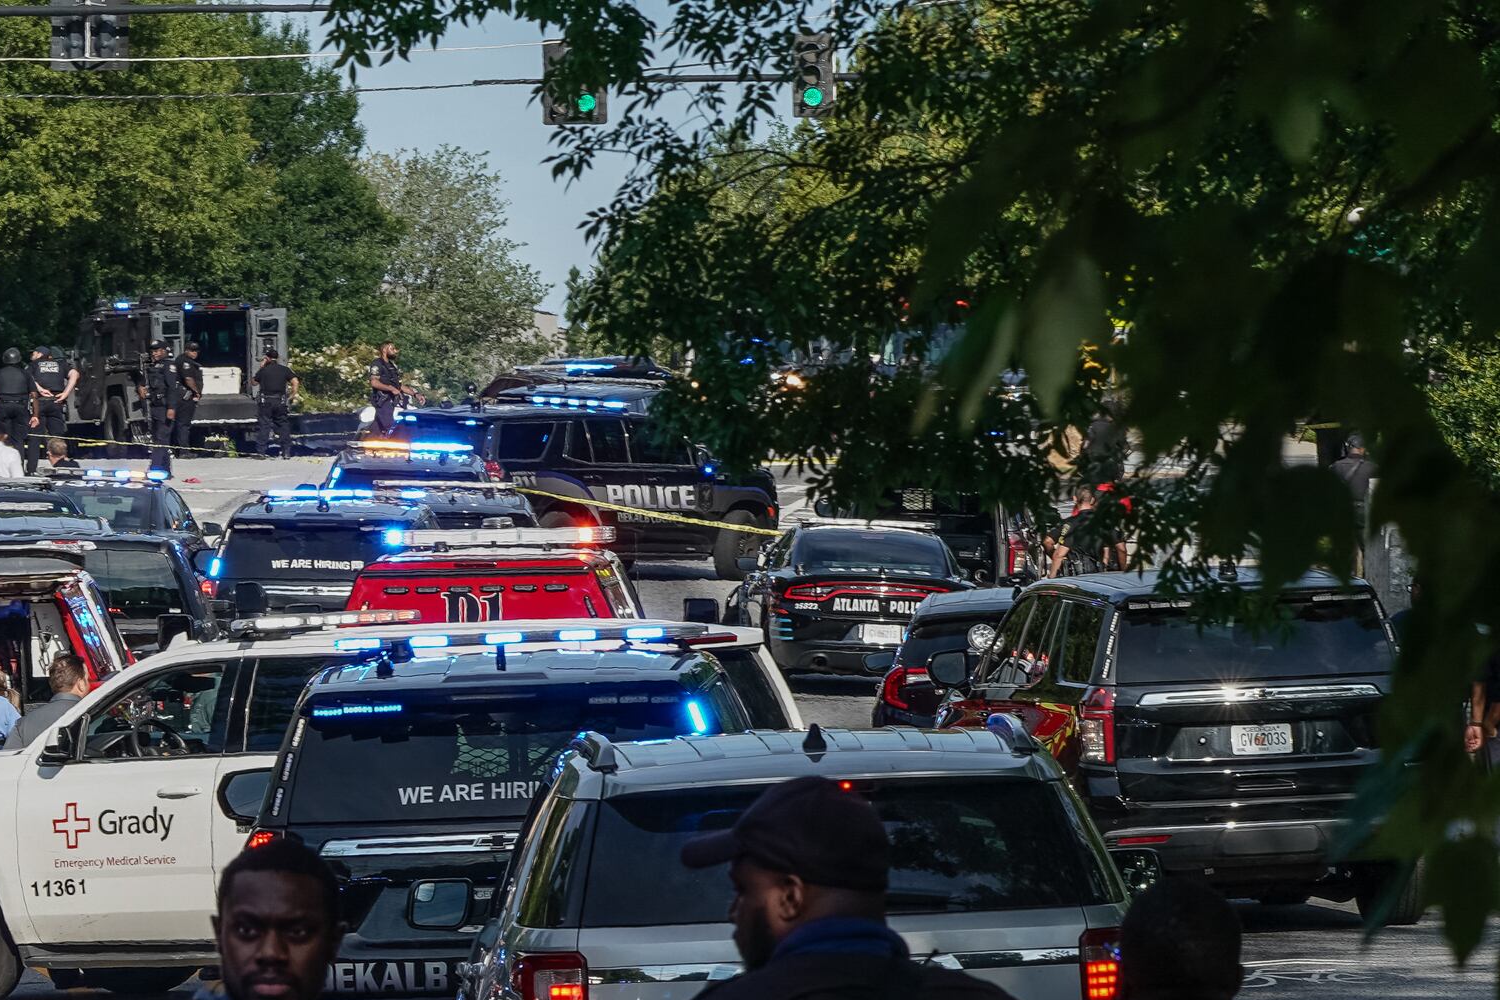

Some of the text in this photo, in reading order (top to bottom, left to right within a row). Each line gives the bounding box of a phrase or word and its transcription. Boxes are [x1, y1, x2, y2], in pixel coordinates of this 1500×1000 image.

[606, 484, 696, 510] POLICE
[271, 559, 351, 570] WE ARE HIRING
[832, 597, 880, 612] ATLANTA
[398, 786, 434, 806] WE
[438, 783, 485, 802] ARE
[98, 806, 175, 841] Grady
[54, 855, 177, 869] Emergency Medical Service
[31, 878, 87, 897] 11361
